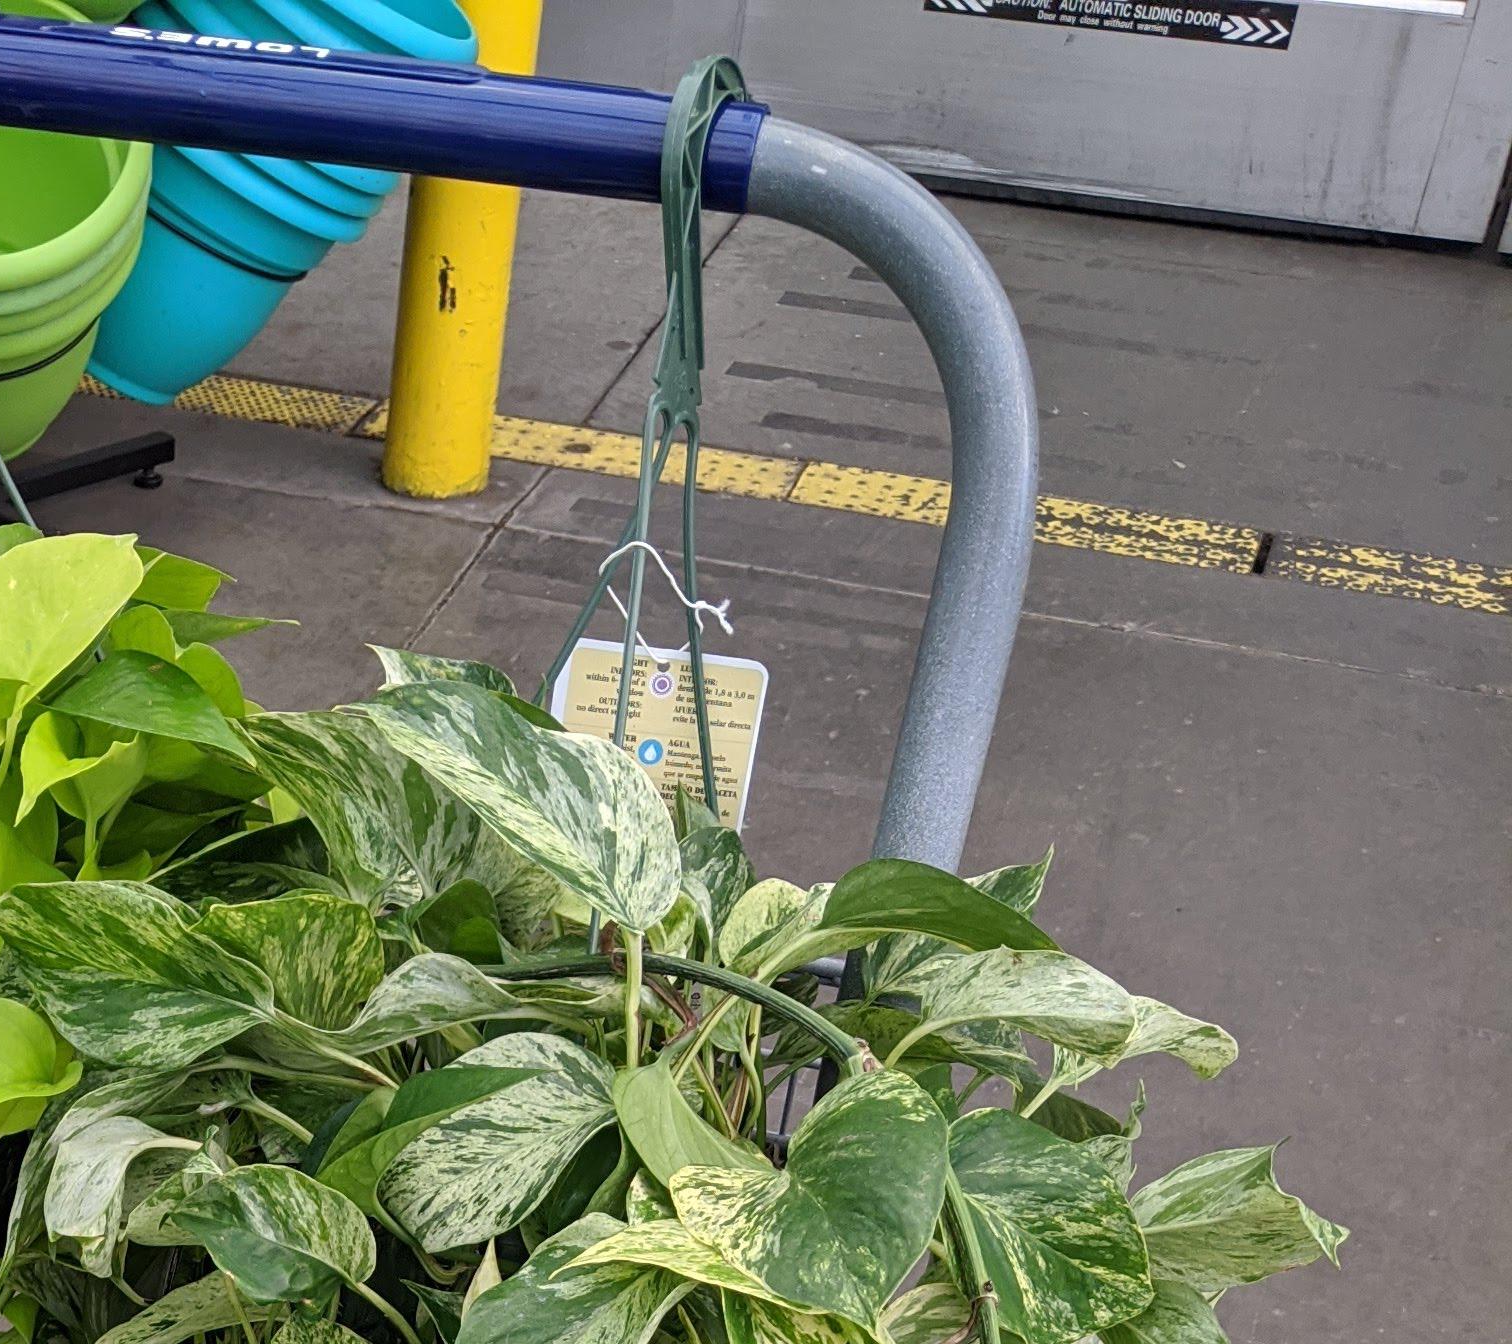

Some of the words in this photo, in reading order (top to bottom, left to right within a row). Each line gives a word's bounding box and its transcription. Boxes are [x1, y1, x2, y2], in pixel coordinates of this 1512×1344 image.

[995, 0, 1051, 9] TION:
[1058, 0, 1132, 17] AUTOMATIC
[1133, 4, 1183, 24] SLIDING
[1184, 10, 1221, 27] DOOR
[1037, 10, 1056, 20] Door
[1059, 14, 1076, 25] may
[1080, 15, 1099, 25] close
[1103, 17, 1134, 29] without
[1137, 22, 1169, 35] warning
[109, 26, 330, 58] LOWE'S
[610, 666, 647, 678] INRS:
[588, 704, 609, 714] direct
[598, 697, 642, 709] OUTRS:
[668, 739, 690, 749] AGUA
[661, 783, 693, 794] TAMO
